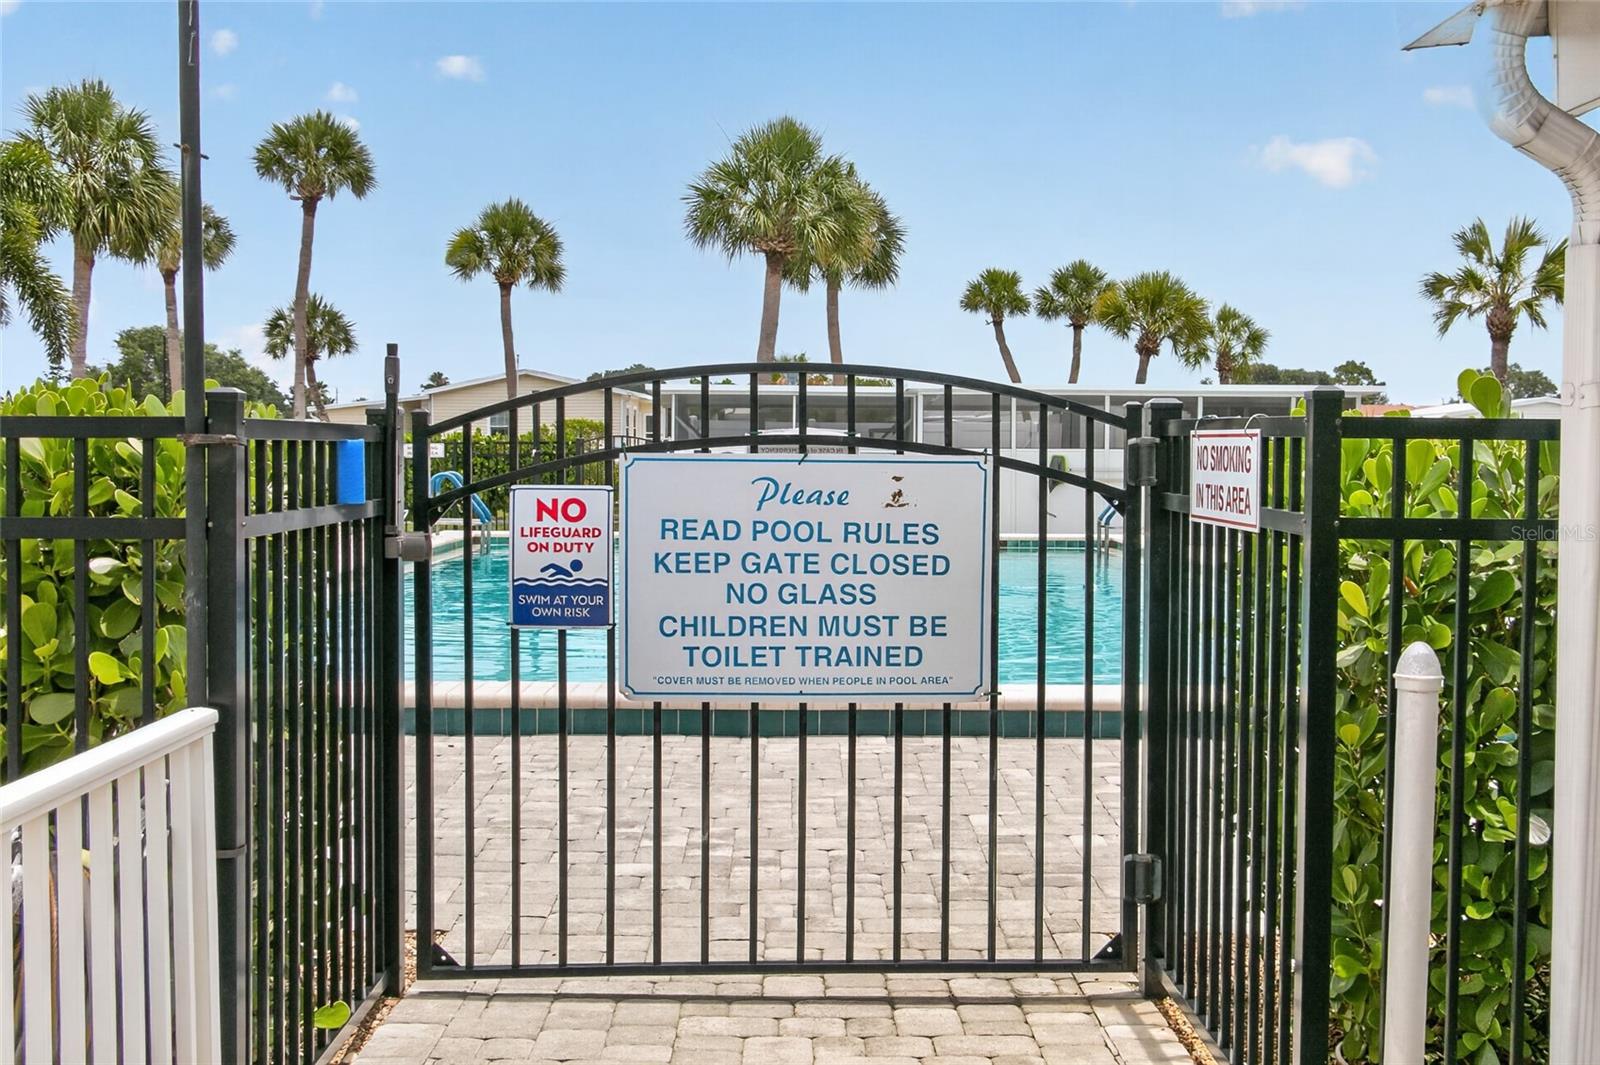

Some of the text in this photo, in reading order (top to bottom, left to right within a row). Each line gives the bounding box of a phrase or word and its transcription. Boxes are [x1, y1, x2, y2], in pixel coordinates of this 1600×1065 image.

[1197, 445, 1252, 474] NO SMOKING
[752, 477, 850, 511] Please
[1196, 483, 1252, 516] IN THIS AREA
[536, 497, 587, 523] NO
[520, 526, 602, 539] LIFEGUARD
[660, 519, 940, 546] READ POOL RULES
[527, 541, 595, 554] ON DUTY
[654, 552, 951, 577] KEEP GATE CLOSED
[518, 594, 604, 606] SWIM AT YOUR
[725, 583, 877, 606] NO GLASS
[531, 607, 590, 618] OWN RISK
[659, 615, 948, 638] CHILDREN MUST BE
[682, 645, 924, 668] TOILET TRAINED
[653, 675, 954, 687] "COVER MUST BE REMOVED WHEN PEOPLE IN POOL AREA"
